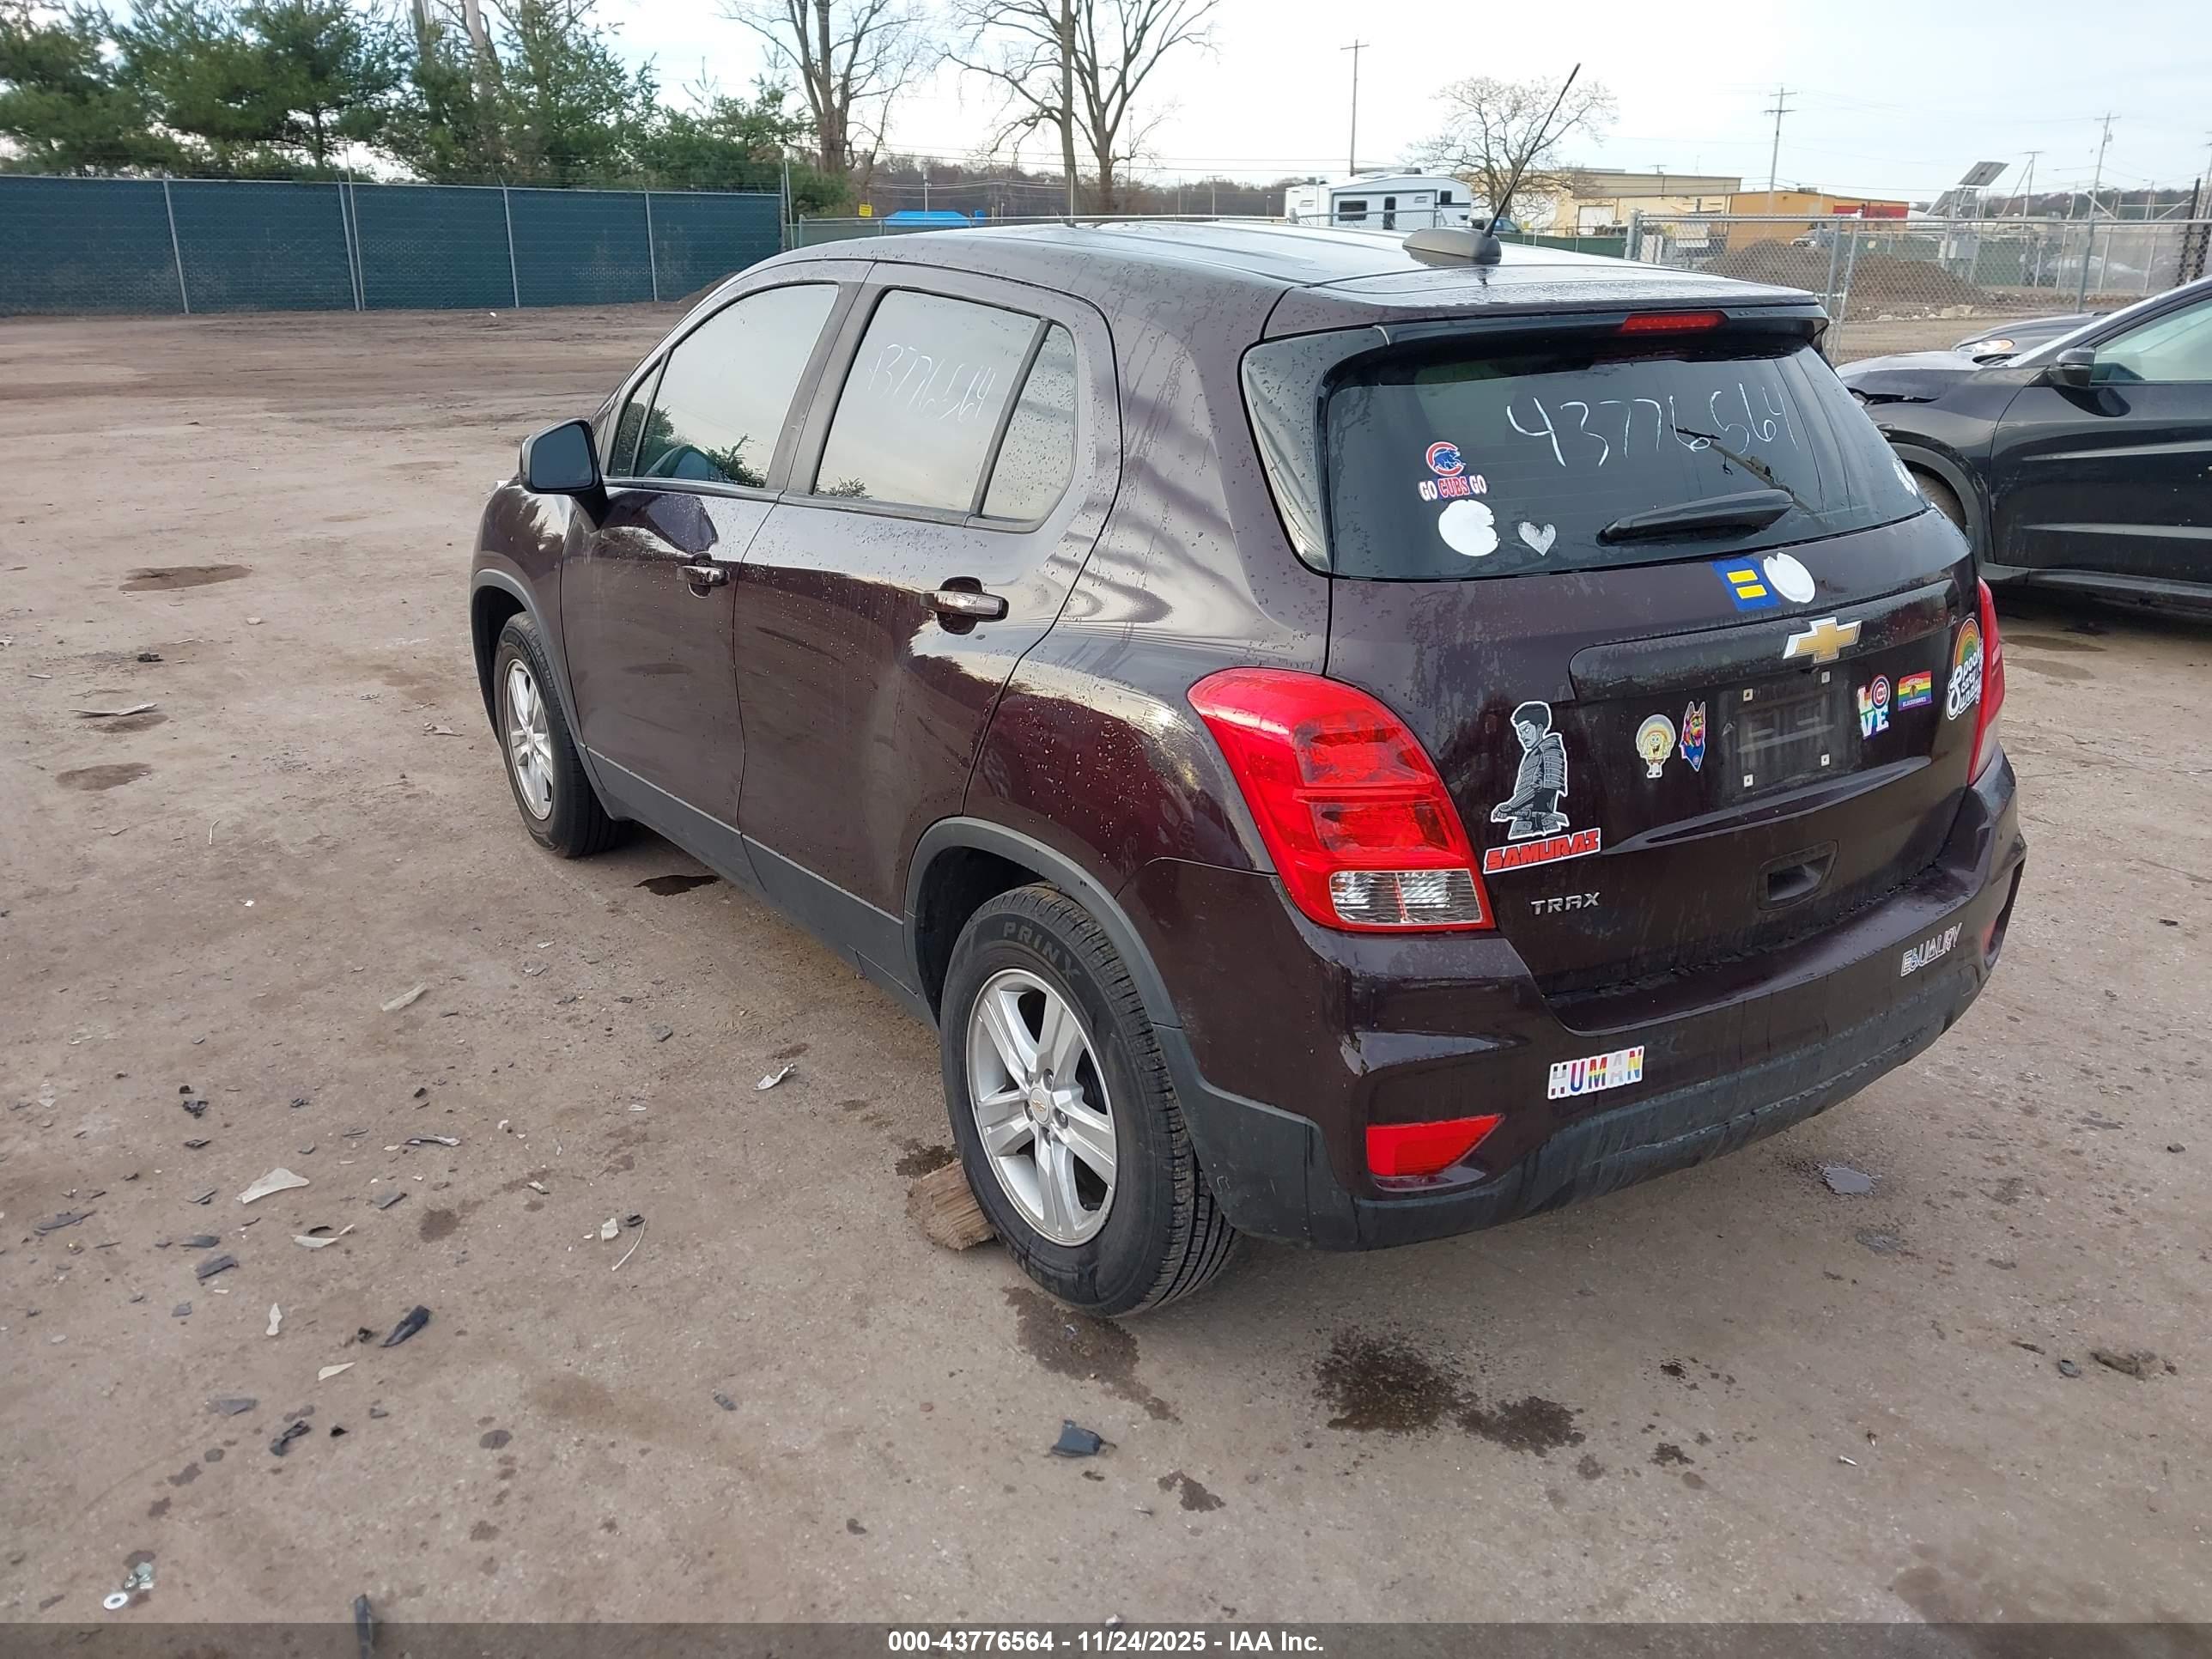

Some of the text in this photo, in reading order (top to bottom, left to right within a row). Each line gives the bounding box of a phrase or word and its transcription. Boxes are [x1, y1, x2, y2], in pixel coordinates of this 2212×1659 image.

[1505, 382, 1800, 468] 43776564
[1418, 474, 1487, 501] GO CUBS GO
[1486, 830, 1600, 871] SAMURAI
[1530, 891, 1601, 916] TRAX
[1003, 921, 1082, 981] PRINX
[1550, 1048, 1643, 1097] HUMAN
